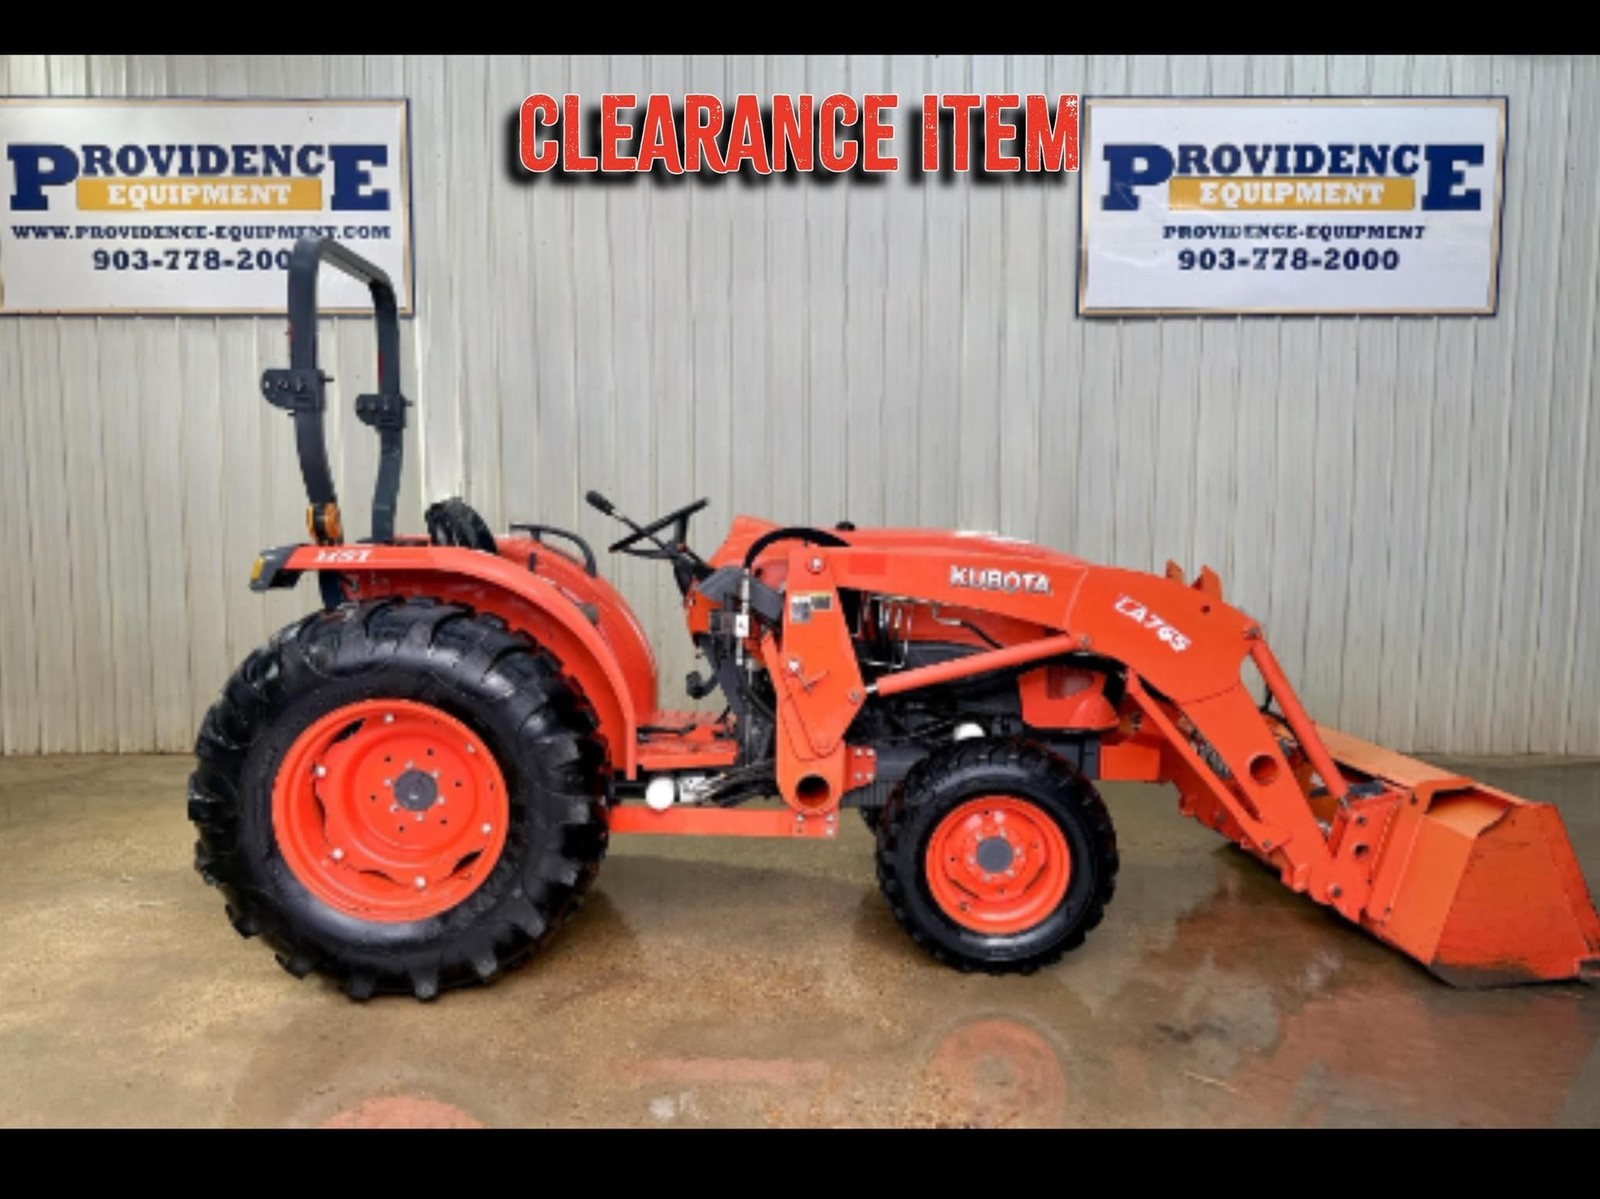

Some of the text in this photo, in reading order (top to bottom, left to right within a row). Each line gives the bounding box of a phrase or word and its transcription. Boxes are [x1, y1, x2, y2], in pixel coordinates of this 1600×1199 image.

[7, 143, 391, 211] PROVIDENCE
[1101, 143, 1485, 211] PROVIDENCE
[106, 184, 292, 210] EQUIPMENT
[1199, 181, 1385, 208] EQUIPMENT
[1162, 224, 1426, 240] PROVIDENCE-EQUIPMENT
[92, 249, 290, 271] 903-778-200
[1177, 247, 1401, 271] 903-778-2000
[949, 564, 1052, 596] KUBOTA
[1114, 594, 1192, 652] LA765
